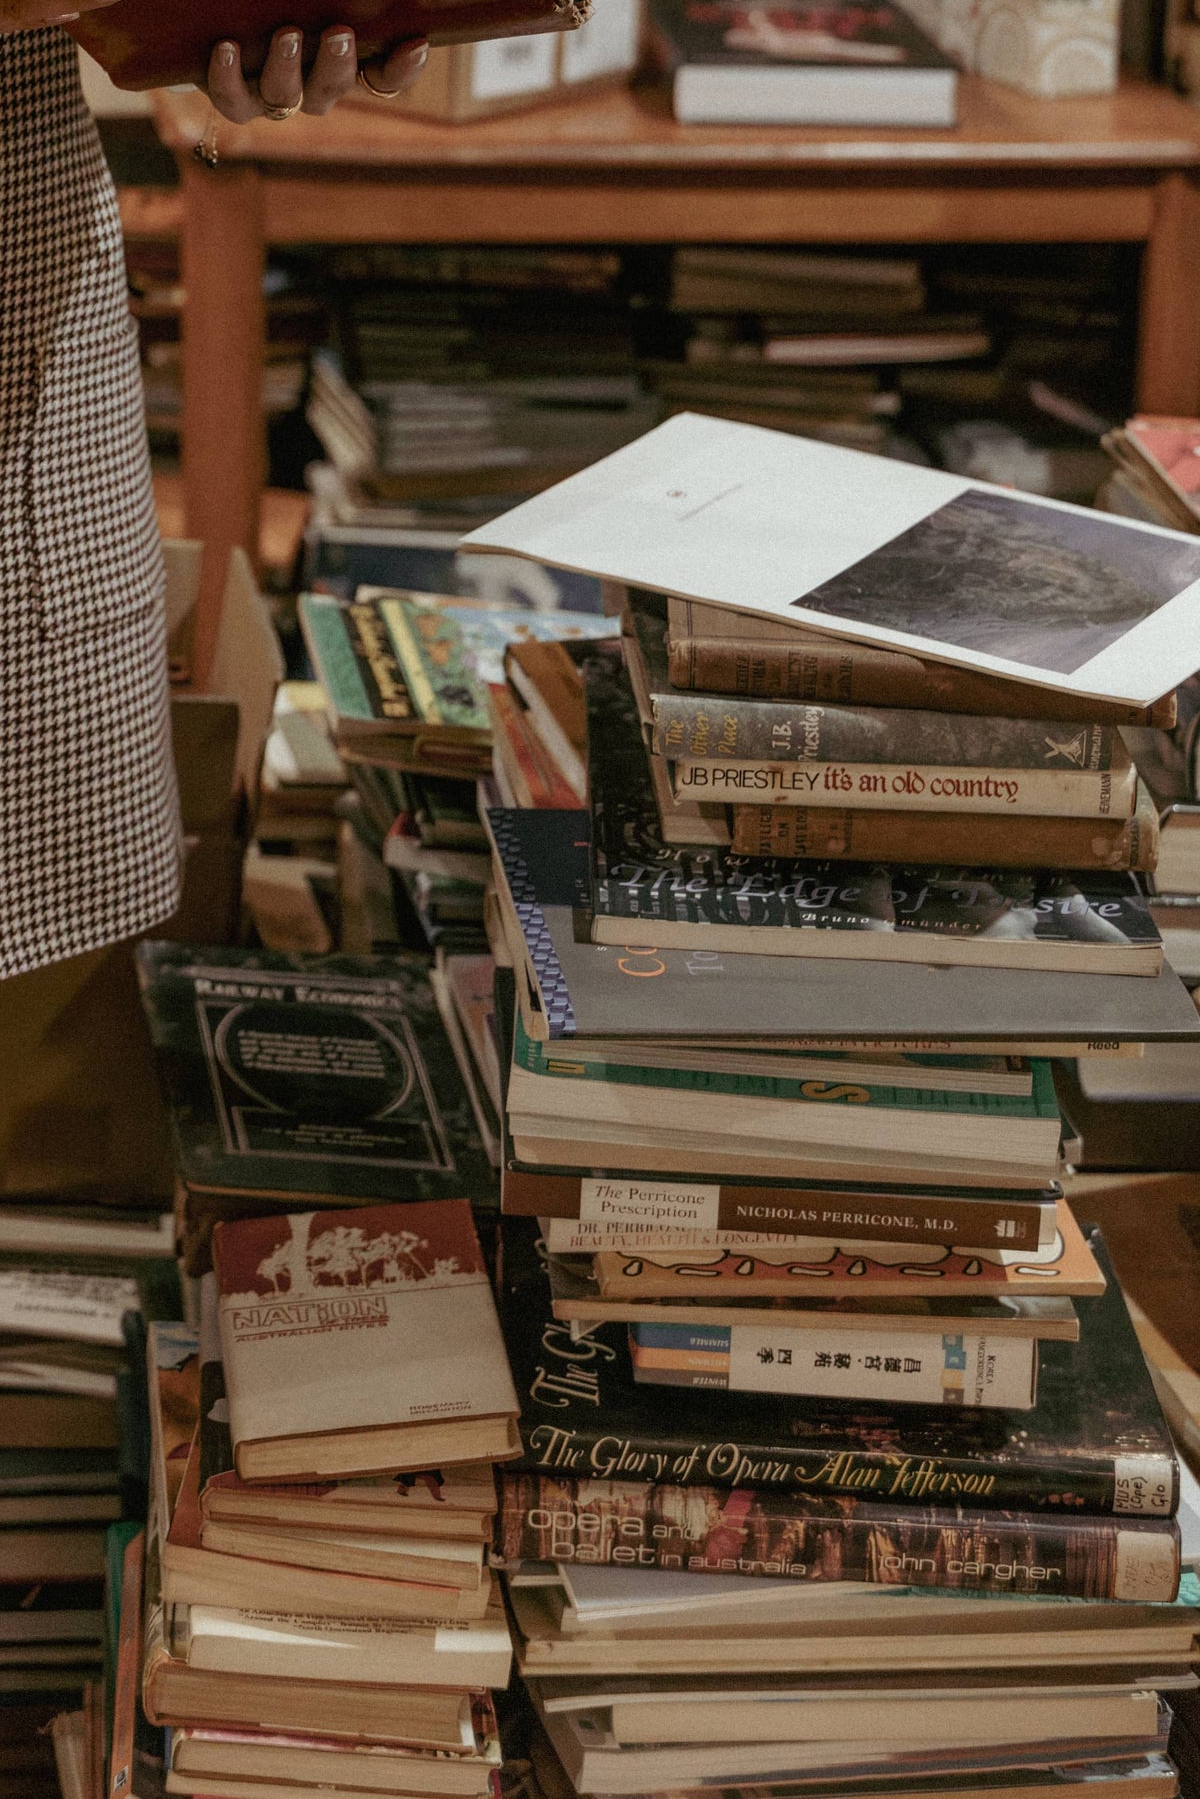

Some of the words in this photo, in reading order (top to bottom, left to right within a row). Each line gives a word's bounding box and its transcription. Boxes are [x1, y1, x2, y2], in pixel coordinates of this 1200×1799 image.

[665, 719, 685, 745] The
[690, 711, 710, 755] Other
[718, 714, 738, 754] Place
[772, 720, 792, 750] J.B.
[798, 706, 825, 762] Priestley
[682, 767, 708, 786] JB
[712, 768, 820, 791] PRIESTLEY
[824, 766, 853, 791] it's
[858, 772, 887, 794] an
[892, 771, 926, 794] old
[930, 774, 1018, 803] country
[611, 863, 709, 893] The
[727, 873, 862, 909] Edge
[802, 912, 870, 924] Bruno
[595, 1185, 623, 1199] The
[629, 1186, 705, 1205] Perricone
[601, 1202, 698, 1220] Prescription
[737, 1205, 818, 1221] NICHOLAS
[822, 1211, 919, 1230] PERRICONE,
[924, 1218, 958, 1231] M.D.
[693, 1376, 728, 1386] WINTER
[529, 1424, 584, 1467] The
[589, 1436, 667, 1479] Glory
[672, 1444, 706, 1482] of
[705, 1442, 790, 1486] Opera
[794, 1451, 881, 1488] Alan
[877, 1453, 996, 1497] Jefferson
[1116, 1478, 1130, 1510] MUS
[528, 1508, 644, 1539] opera
[652, 1523, 702, 1541] and
[551, 1539, 655, 1564] ballet
[660, 1550, 681, 1566] in
[688, 1554, 807, 1575] australia
[879, 1553, 936, 1574] john
[946, 1559, 1061, 1581] cargher
